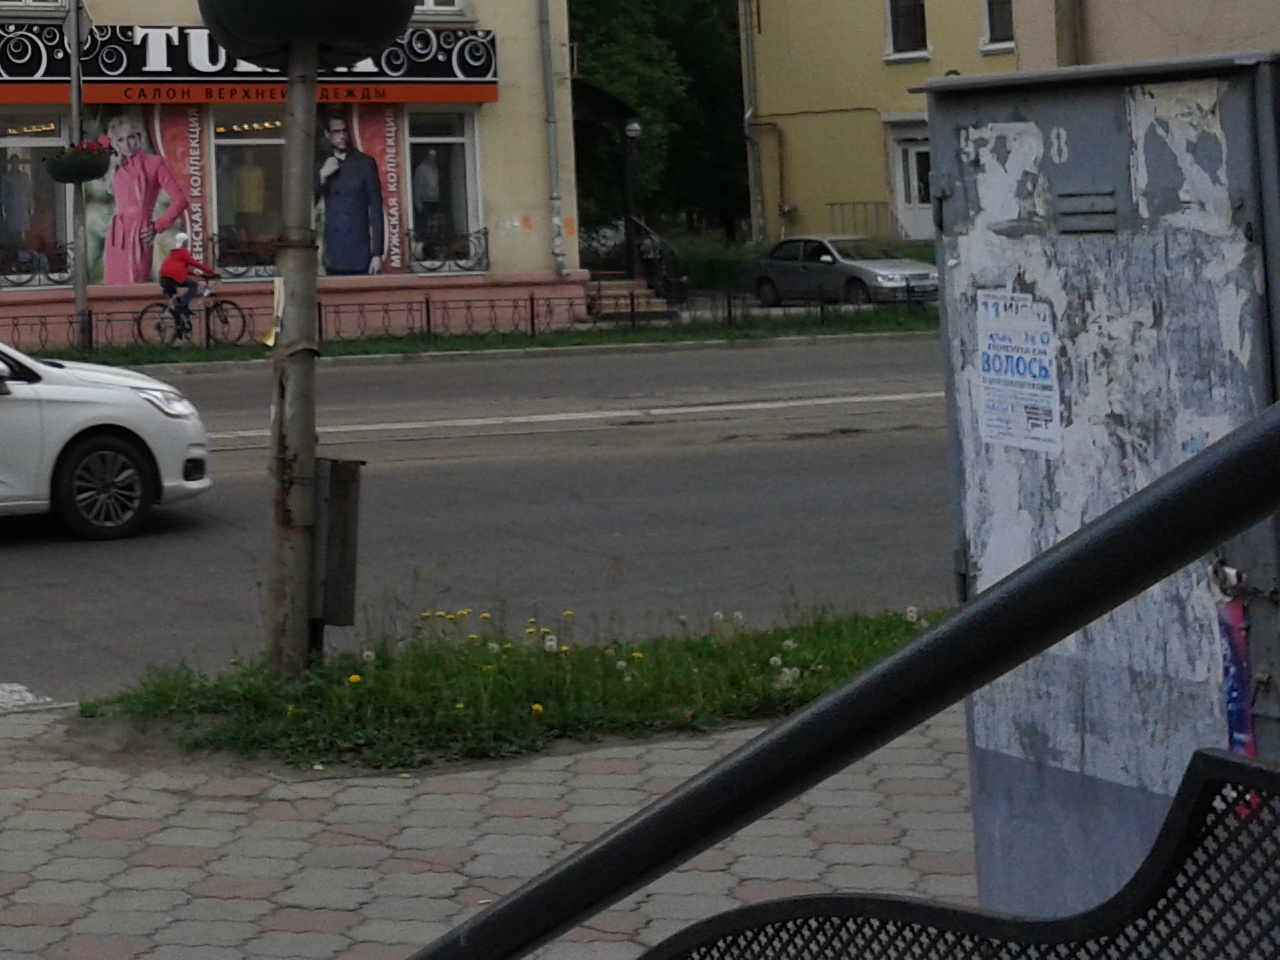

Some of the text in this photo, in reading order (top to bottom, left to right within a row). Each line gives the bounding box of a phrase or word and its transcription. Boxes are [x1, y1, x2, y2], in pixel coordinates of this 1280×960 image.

[124, 87, 192, 100] САЛОН
[320, 87, 387, 101] ДЕЖДЫ
[188, 108, 203, 197] КОЛЛЕКЦИЯ
[388, 197, 401, 268] МУЖСКАЯ
